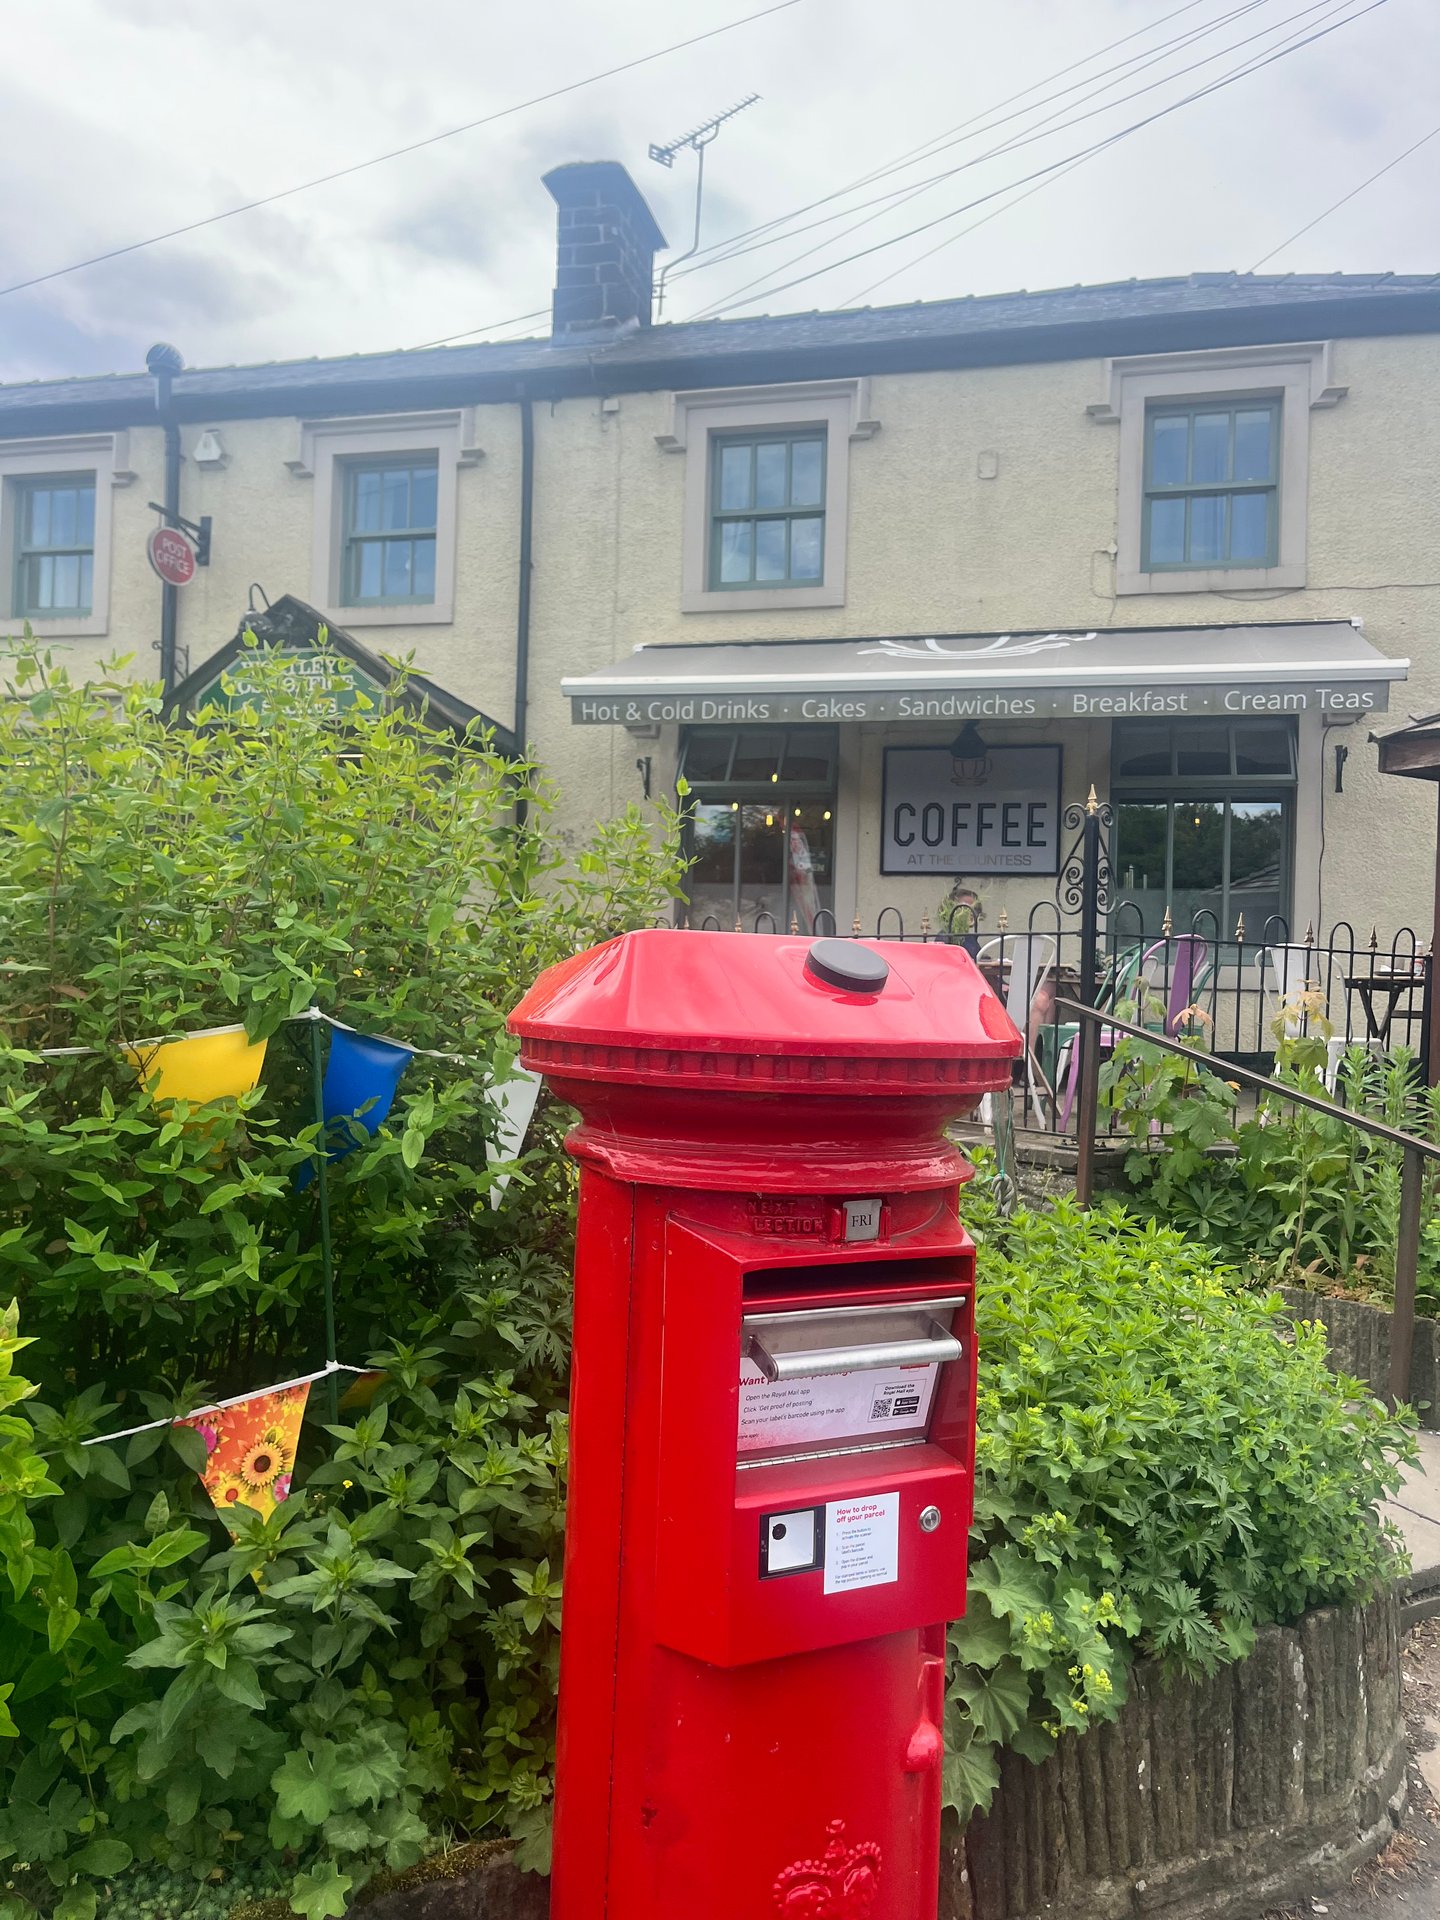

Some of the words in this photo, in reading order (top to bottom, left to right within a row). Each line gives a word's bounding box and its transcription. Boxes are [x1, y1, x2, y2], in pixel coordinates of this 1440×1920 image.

[162, 537, 187, 559] POST
[156, 550, 190, 576] OFFICE
[240, 655, 336, 675] TLEY
[582, 702, 620, 721] Hot
[625, 702, 642, 721] &
[648, 700, 694, 720] Cold
[701, 699, 770, 720] Drinks
[801, 698, 866, 718] Cakes
[898, 694, 1036, 716] Sandwiches
[1072, 691, 1188, 713] Breakfast
[1224, 691, 1307, 711] Cream
[1315, 689, 1374, 709] Teas
[893, 802, 1047, 847] COFFEE
[907, 854, 925, 866] AT
[929, 854, 953, 866] THE
[748, 1201, 796, 1214] NEXT
[851, 1214, 873, 1227] FRI
[739, 1376, 766, 1386] Want
[745, 1394, 761, 1402] Open
[771, 1391, 787, 1399] Royal
[770, 1403, 785, 1411] proof
[787, 1411, 810, 1420] barcode
[809, 1409, 825, 1417] using
[861, 1504, 878, 1512] drop
[847, 1514, 862, 1523] your
[864, 1510, 885, 1519] parcel
